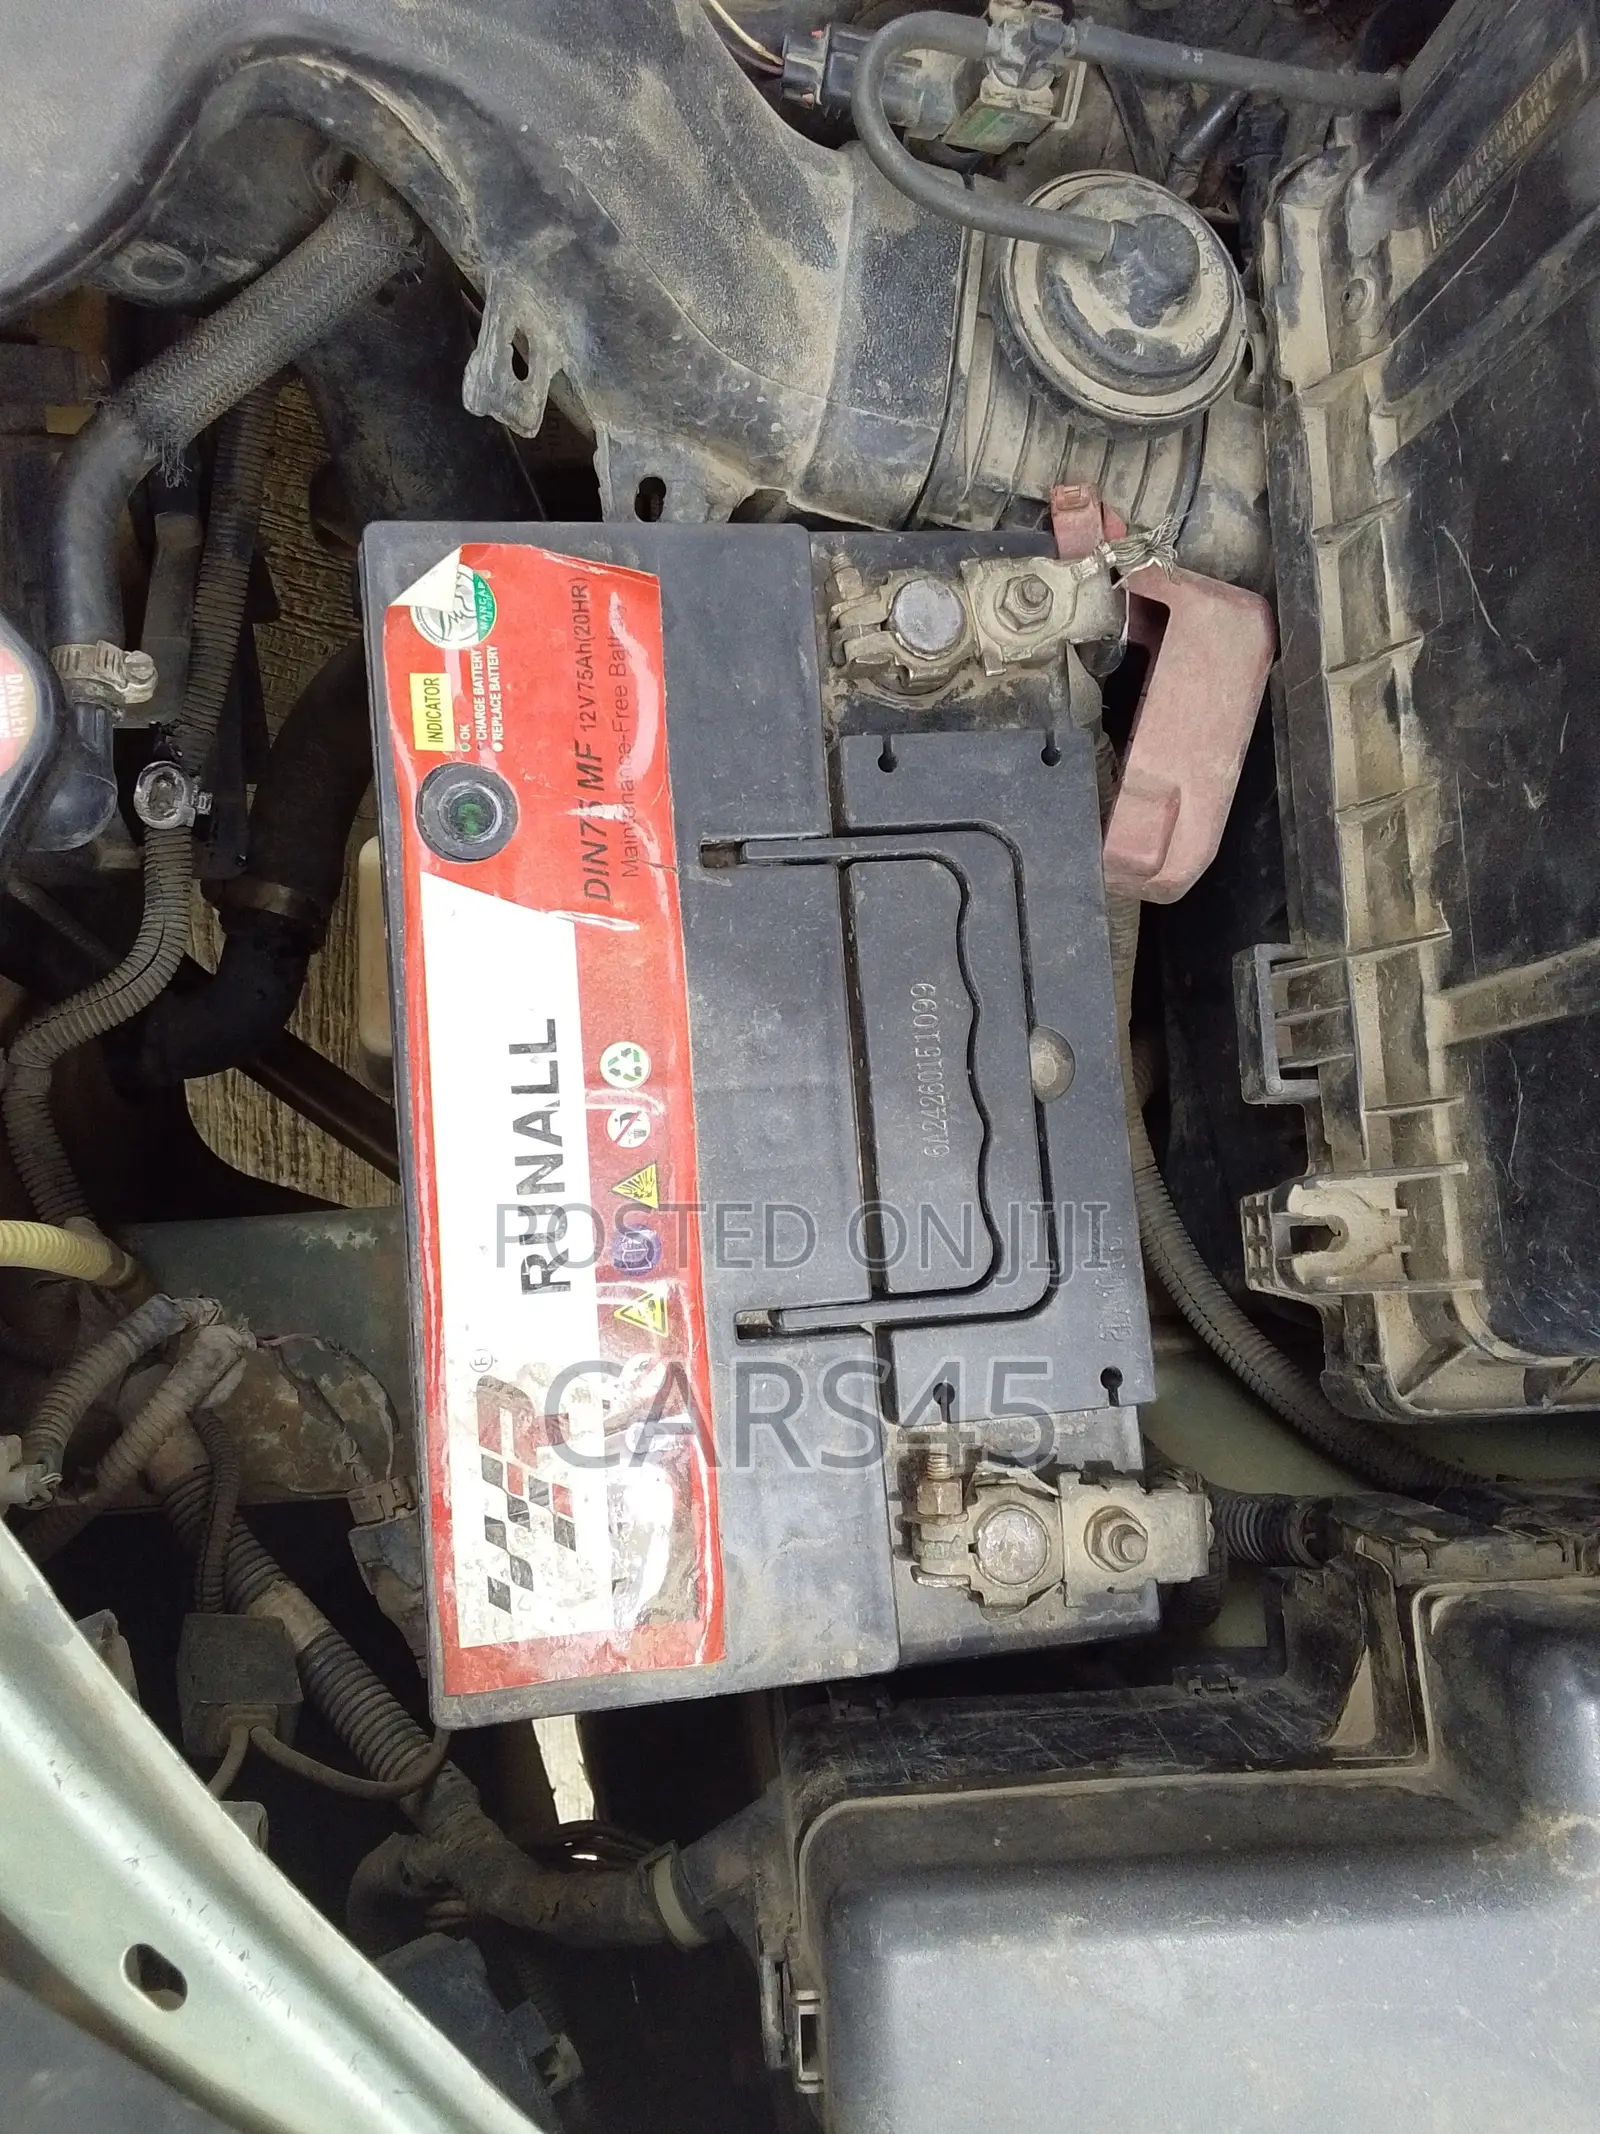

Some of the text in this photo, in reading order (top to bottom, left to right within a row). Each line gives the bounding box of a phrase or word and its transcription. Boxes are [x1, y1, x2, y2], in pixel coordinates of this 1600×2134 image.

[607, 602, 628, 677] Batty
[423, 677, 444, 744] INDICATOR
[460, 724, 471, 740] OK
[471, 649, 488, 741] CHARGE BATTERY
[486, 645, 504, 741] REPLACE BATTERY
[575, 739, 605, 791] MF
[577, 799, 612, 902] DIN75
[508, 1018, 571, 1295] RUNALL
